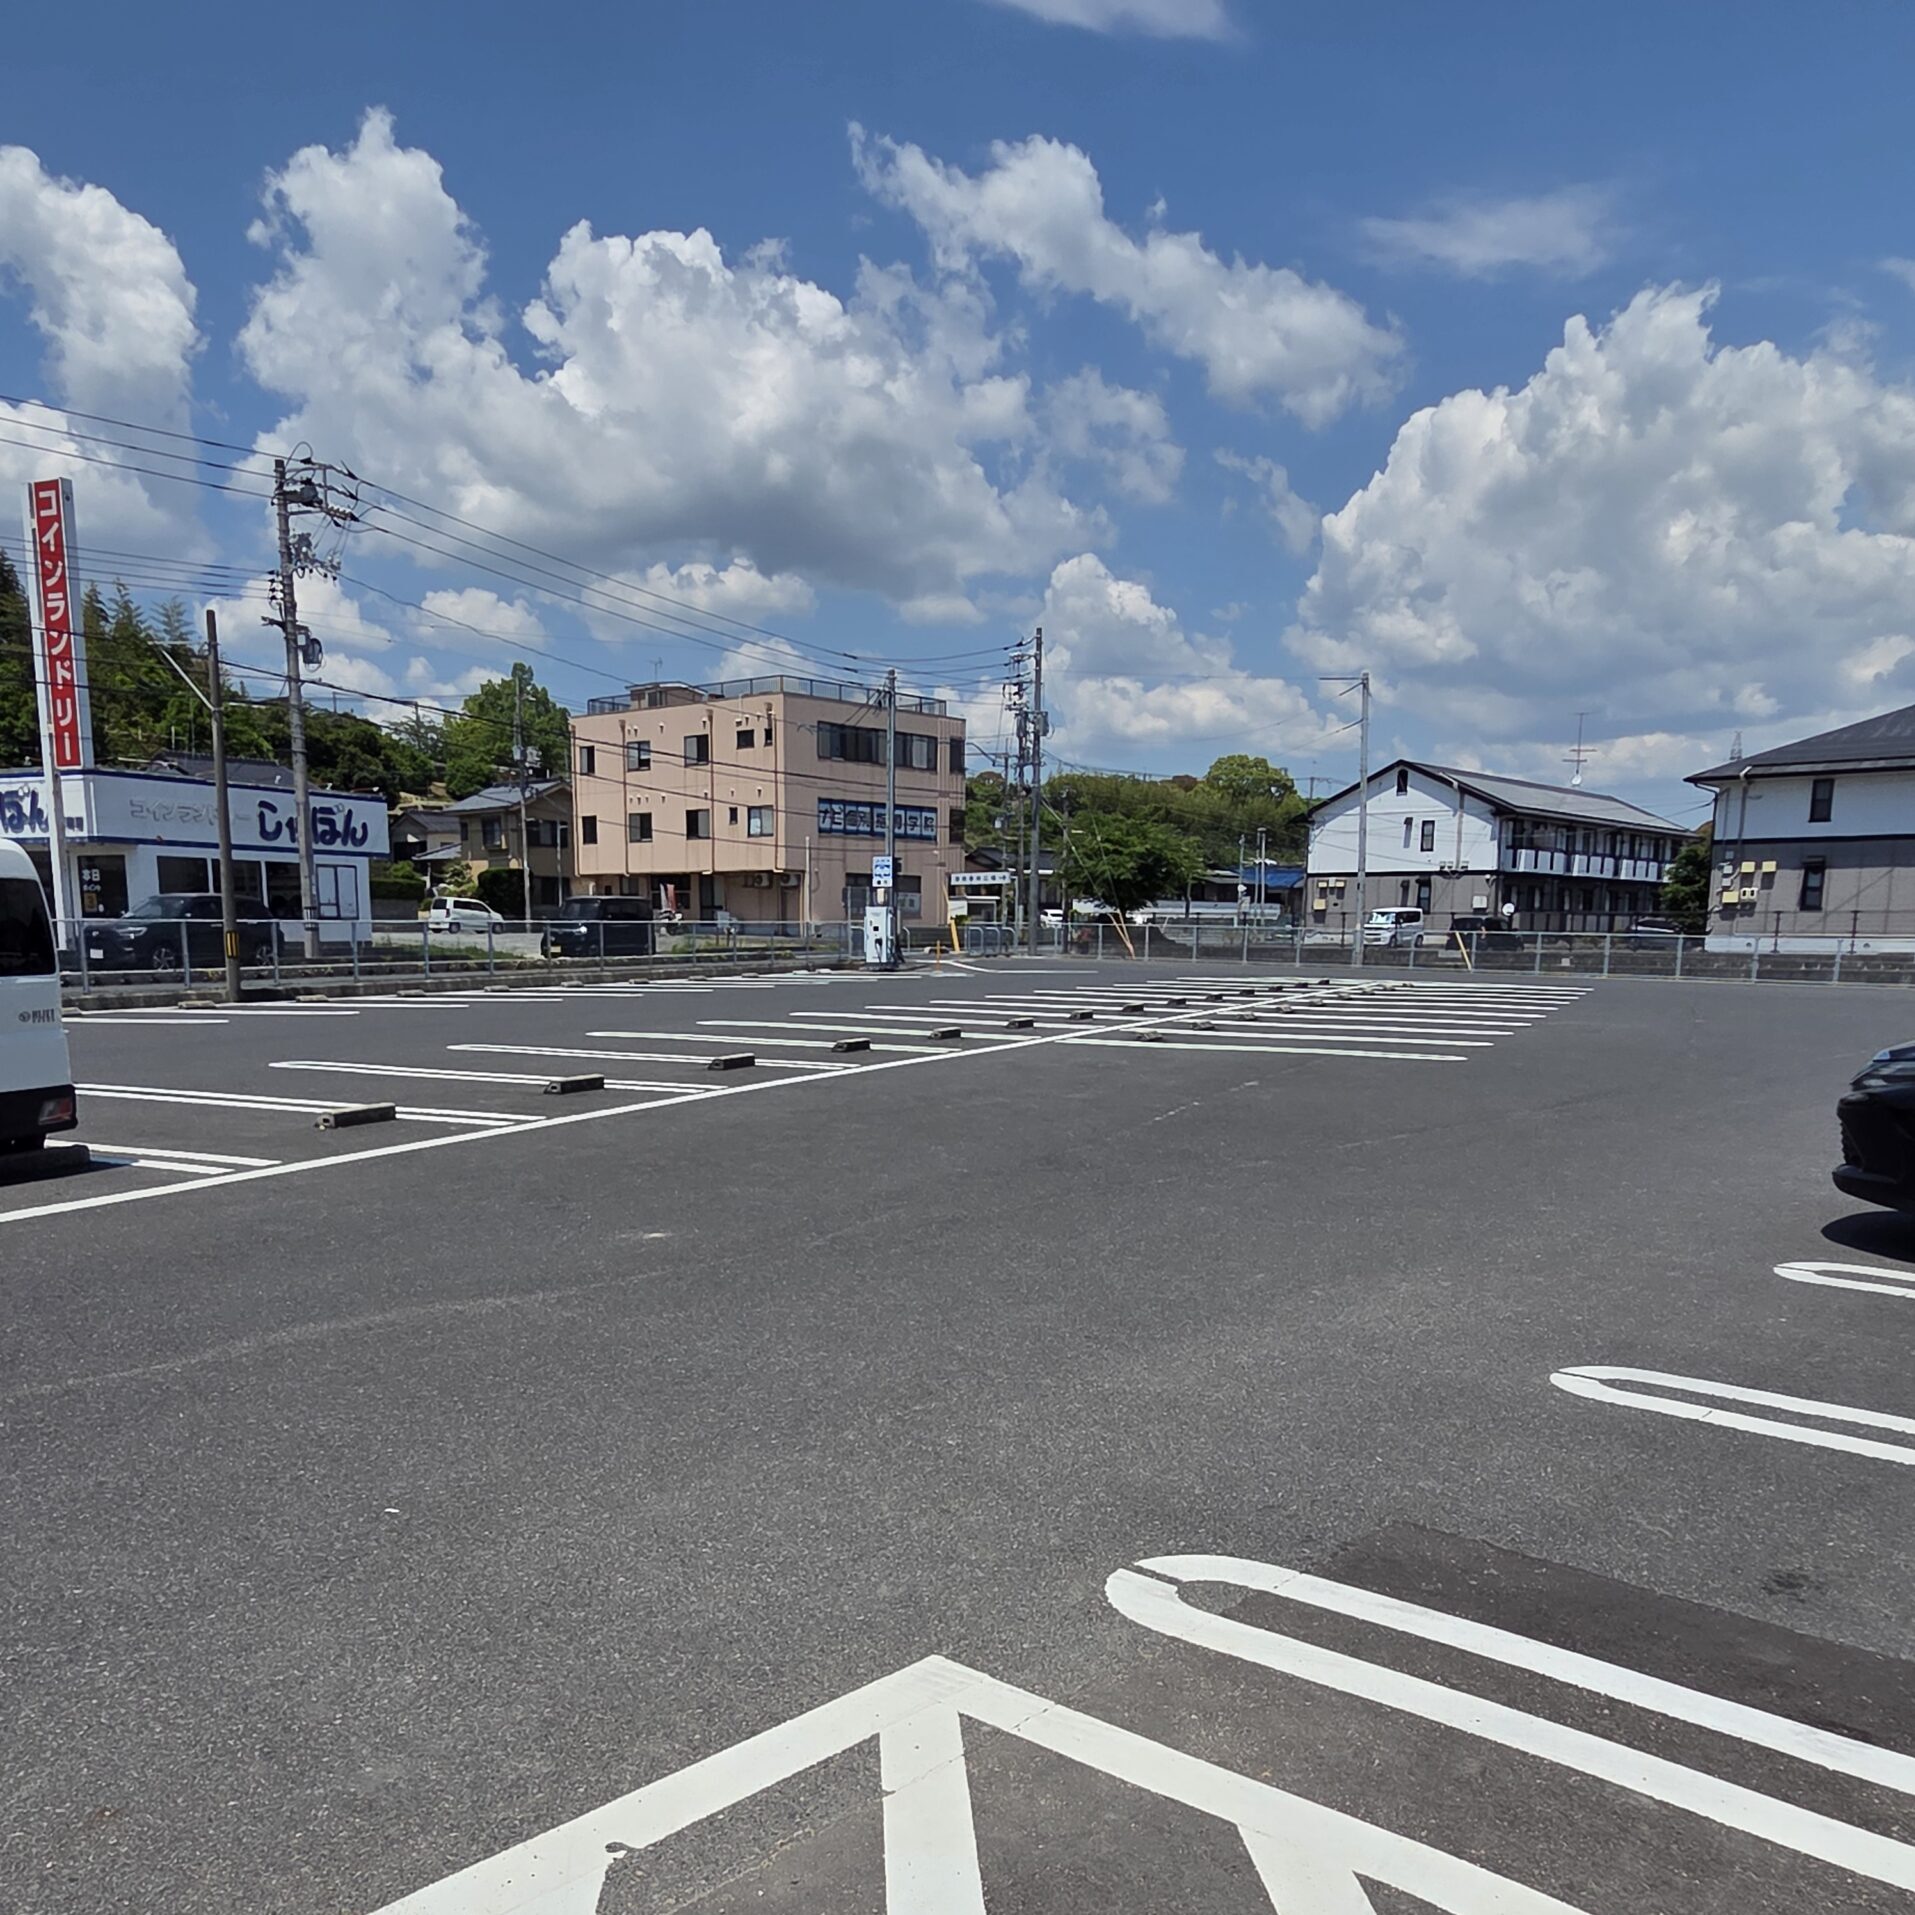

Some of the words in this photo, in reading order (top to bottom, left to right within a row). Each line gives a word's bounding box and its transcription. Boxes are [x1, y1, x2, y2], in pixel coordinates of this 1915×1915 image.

[39, 490, 72, 761] コインランドリー
[129, 798, 250, 826] コインランドー
